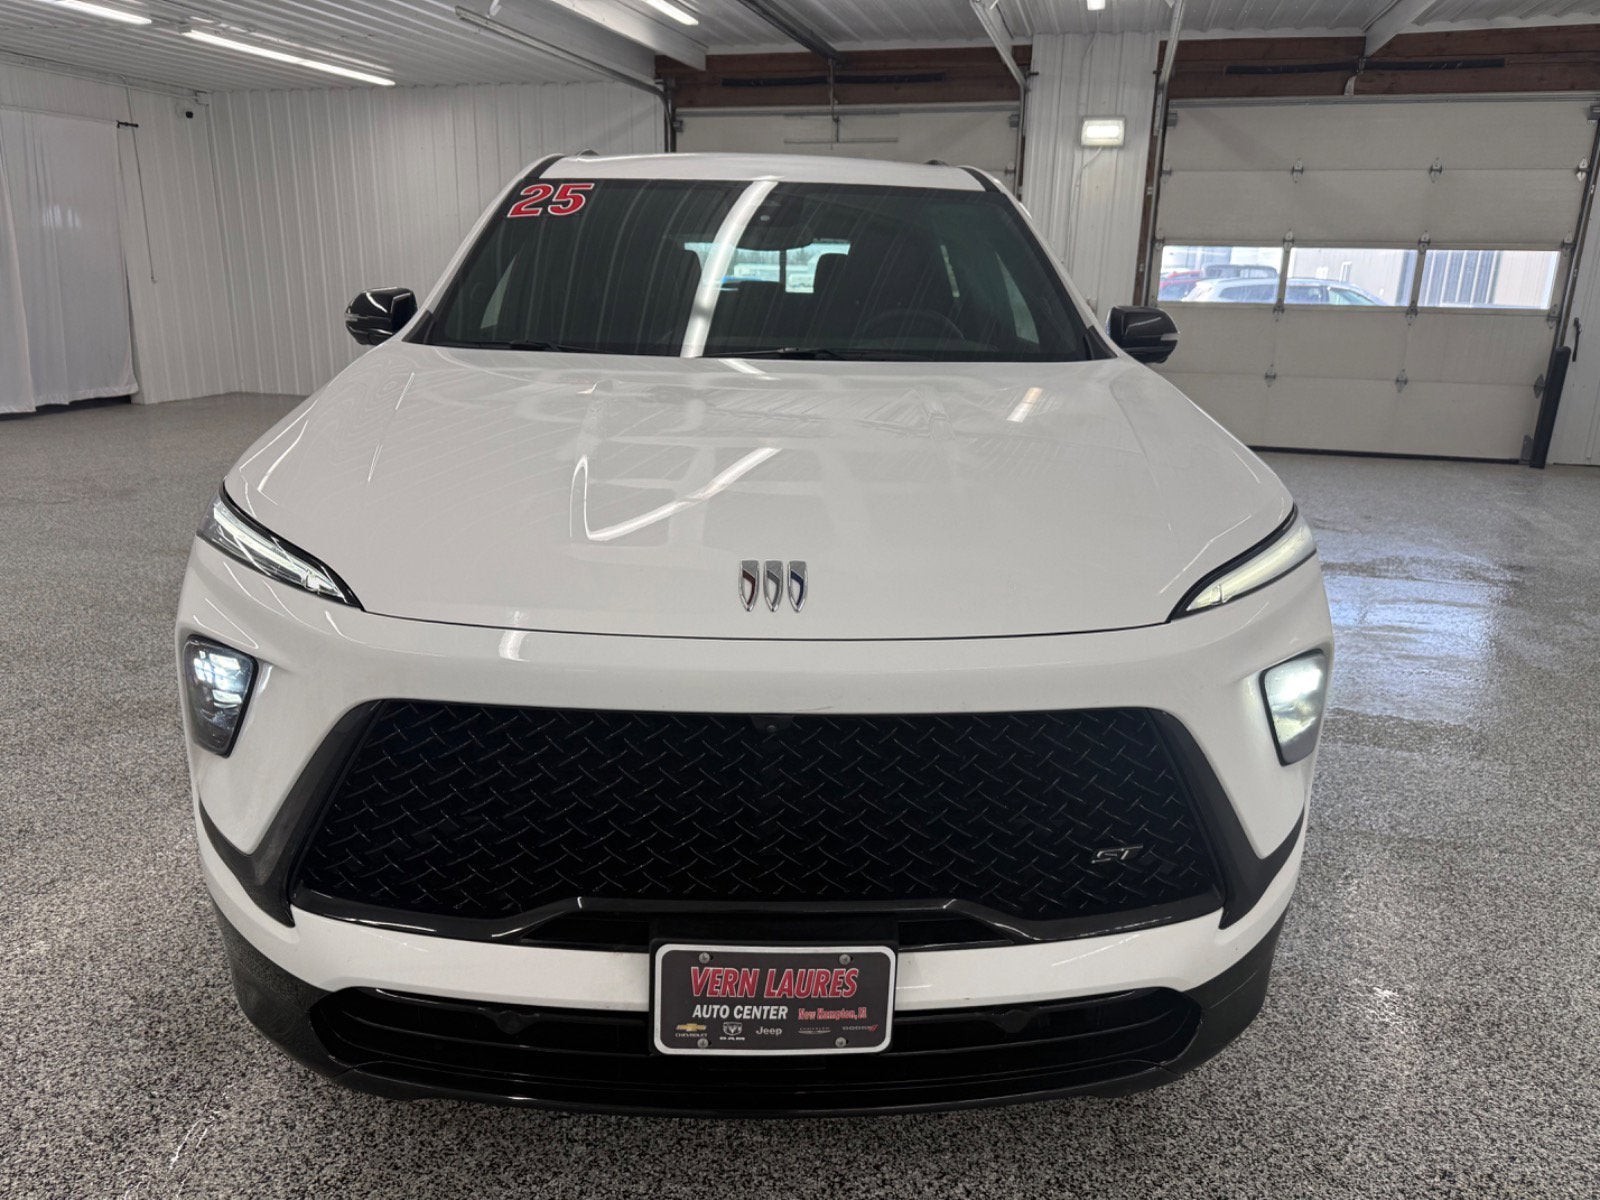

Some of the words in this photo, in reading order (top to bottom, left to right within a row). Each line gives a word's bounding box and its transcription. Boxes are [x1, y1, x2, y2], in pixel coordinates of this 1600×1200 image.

[507, 183, 595, 218] 25
[690, 966, 760, 998] VERN
[763, 968, 859, 999] LAURES
[692, 1004, 730, 1019] AUTO
[733, 1005, 788, 1020] CENTER
[798, 1007, 816, 1020] New
[755, 1026, 783, 1036] Jeep
